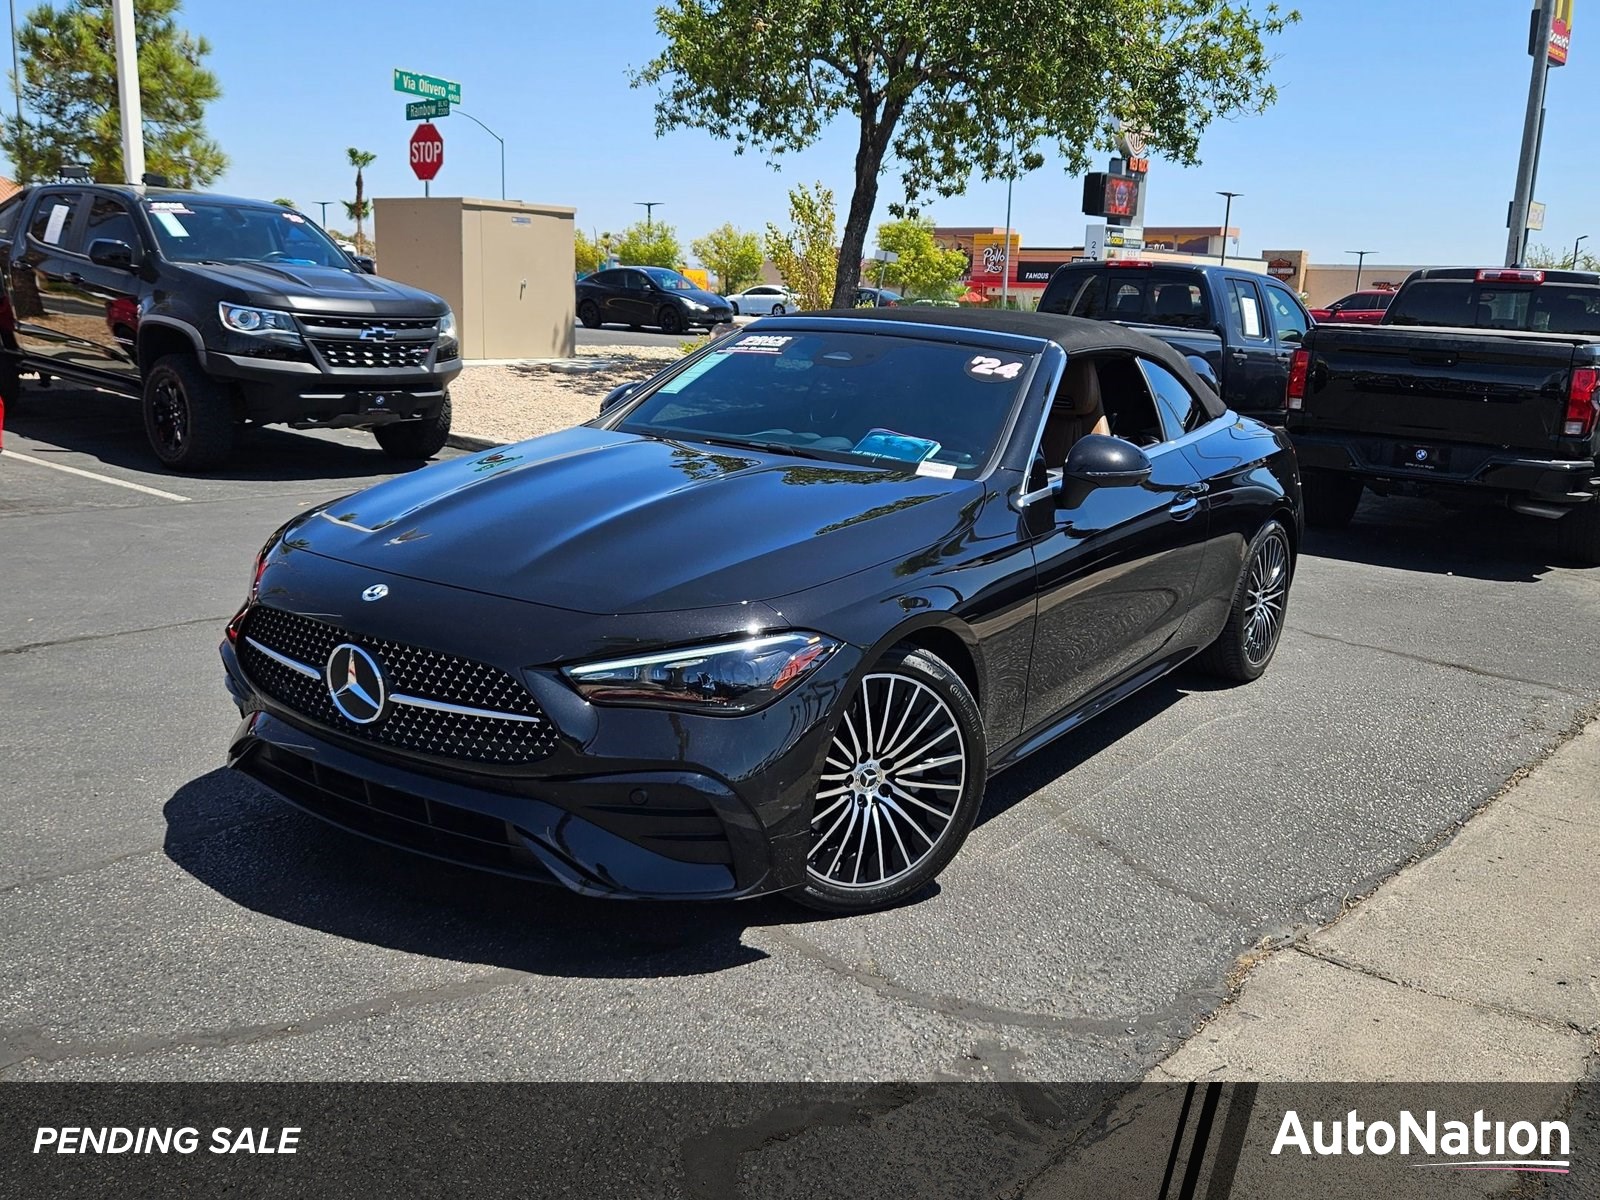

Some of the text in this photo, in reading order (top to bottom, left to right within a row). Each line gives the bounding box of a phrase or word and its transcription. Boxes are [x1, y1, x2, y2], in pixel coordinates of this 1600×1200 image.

[403, 75, 416, 90] Via
[418, 78, 446, 97] Olivero
[410, 104, 436, 117] Rainbow
[411, 141, 442, 163] STOP
[1091, 240, 1097, 249] 2
[983, 247, 1006, 266] Pollo
[984, 261, 1003, 273] Loco
[1025, 272, 1049, 280] FAMOUS
